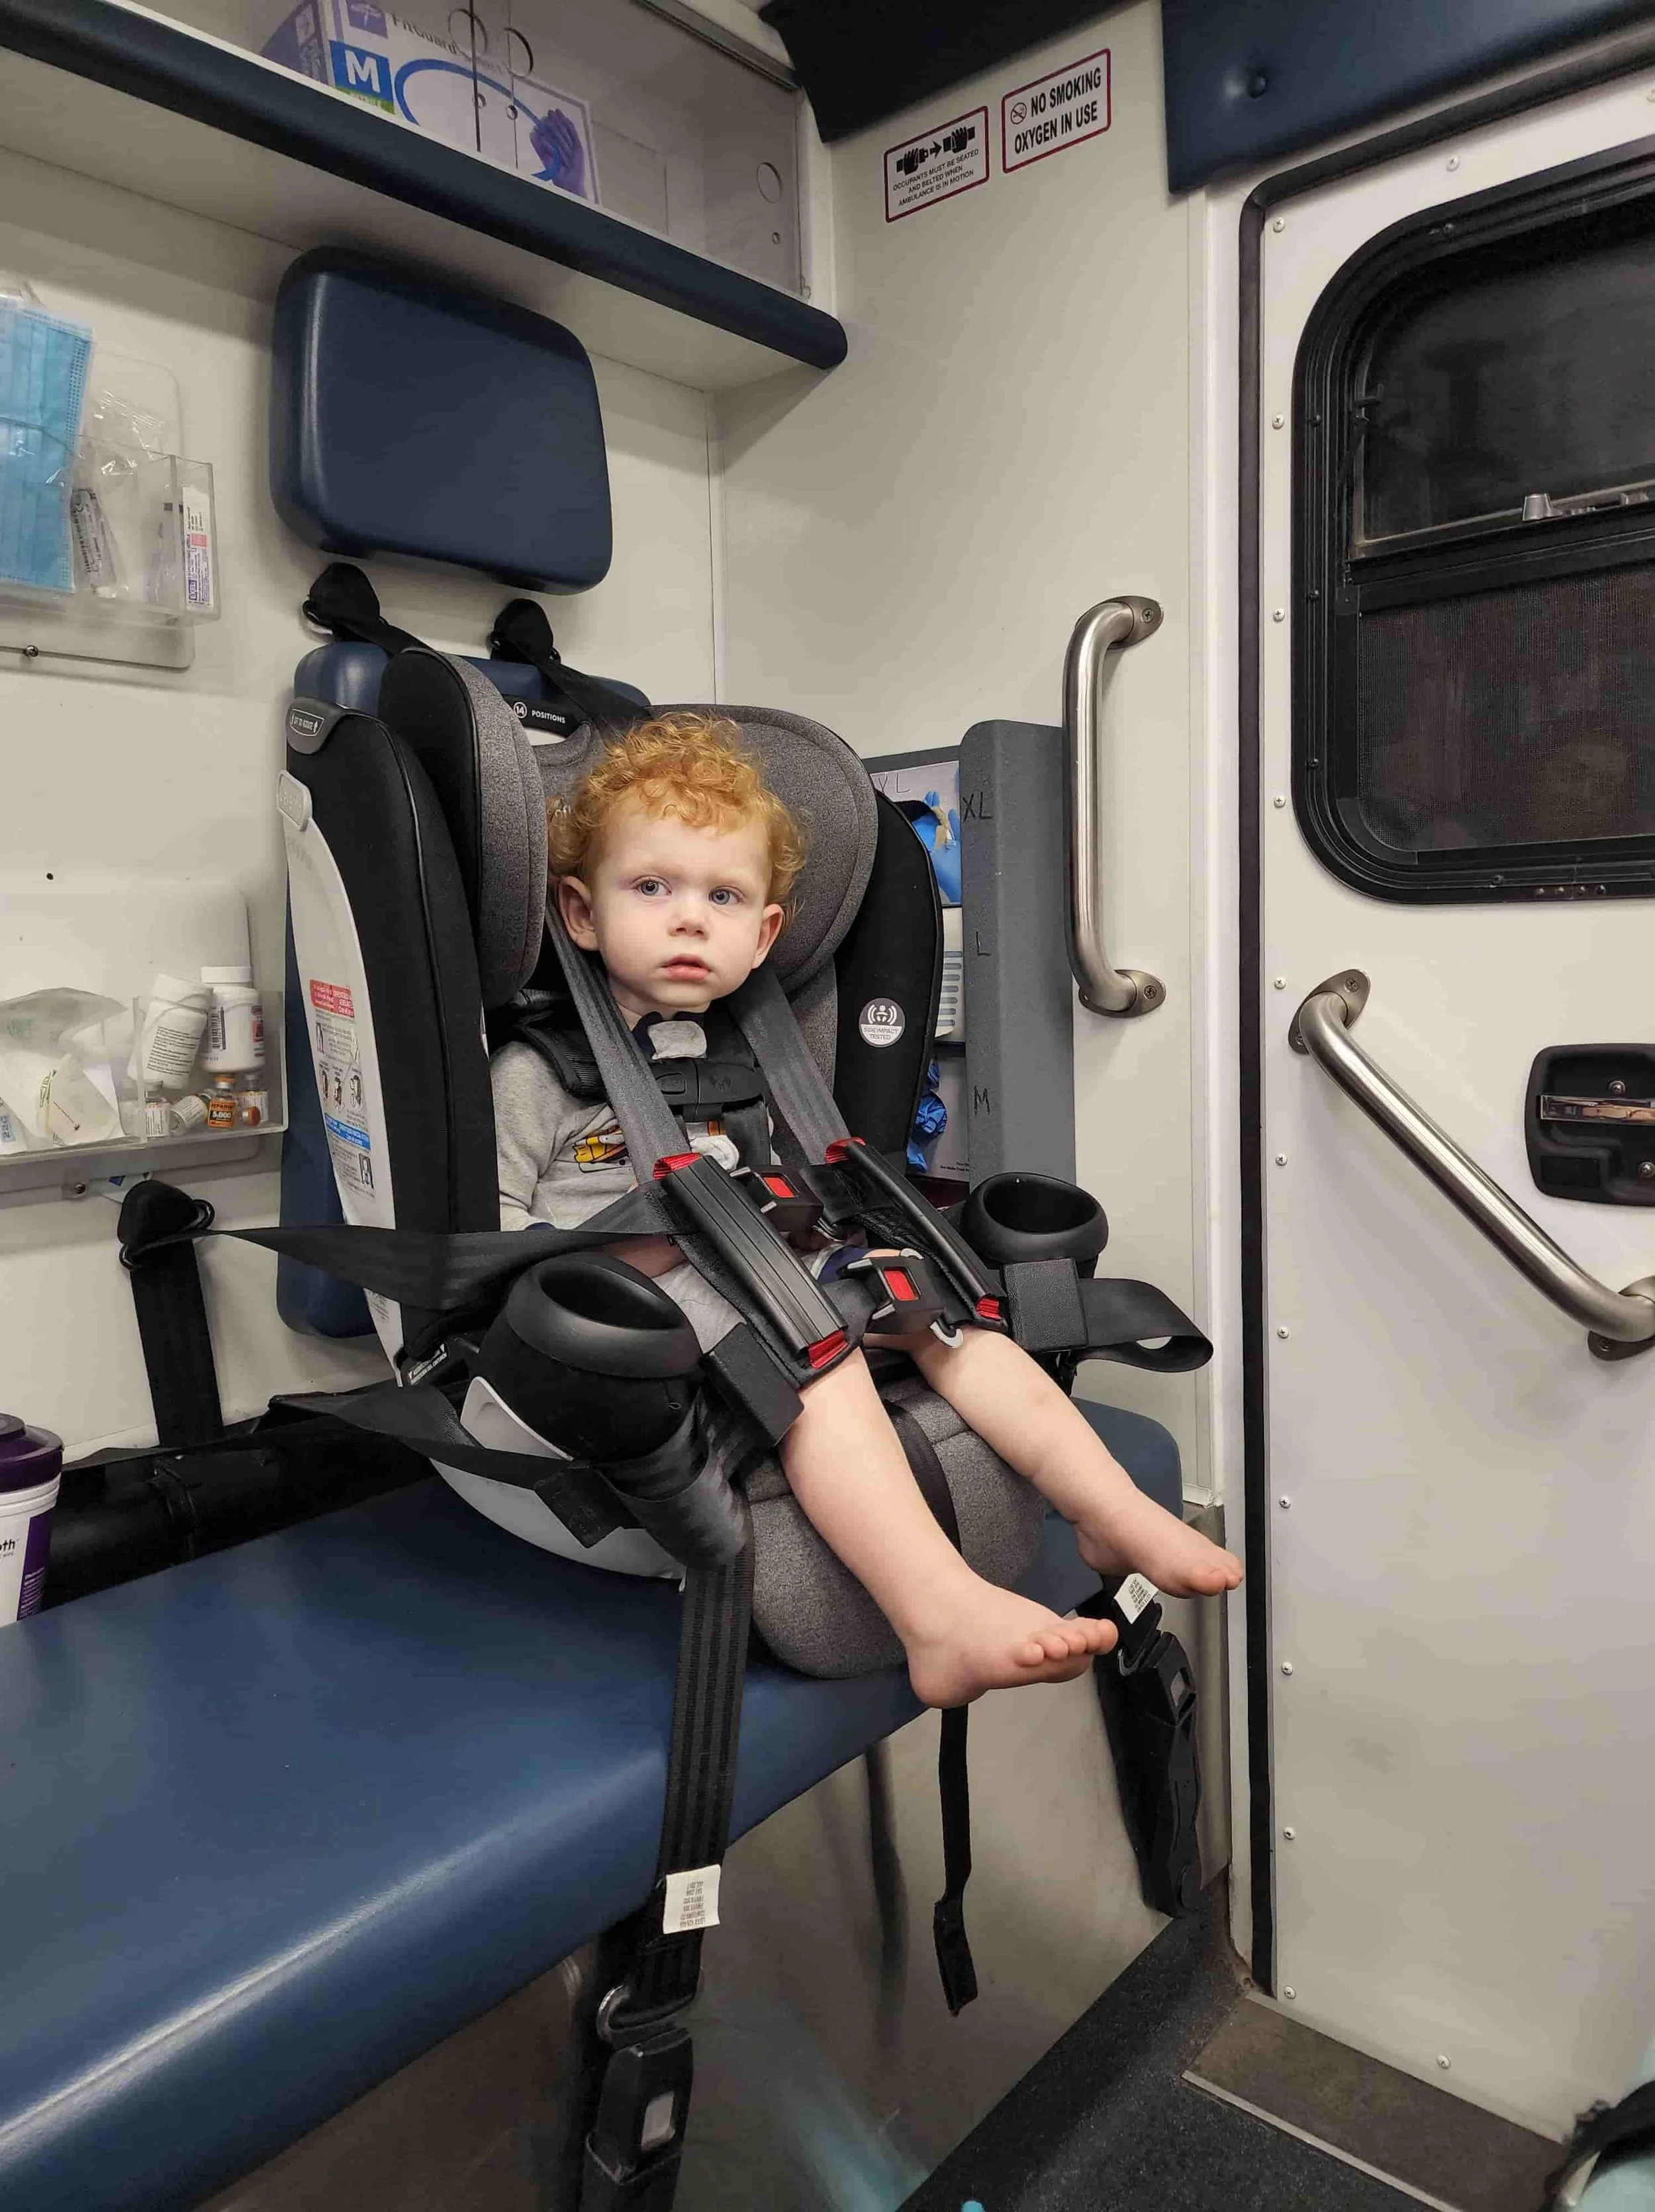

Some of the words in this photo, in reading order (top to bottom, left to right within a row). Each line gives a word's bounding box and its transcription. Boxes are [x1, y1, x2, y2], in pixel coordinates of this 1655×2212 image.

[344, 50, 381, 93] M
[1031, 93, 1046, 117] NO
[1049, 67, 1101, 108] SMOKING
[1014, 117, 1057, 154] OXYGEN
[1061, 111, 1072, 135] IN
[1076, 100, 1098, 128] USE
[892, 171, 927, 191] OCCUPANTS
[929, 163, 946, 175] MUST
[956, 149, 979, 162] SEATED
[908, 183, 921, 193] AND
[922, 173, 944, 187] BELTED
[945, 165, 963, 177] WHEN
[898, 187, 935, 207] AMBULANCE
[942, 178, 949, 187] IN
[949, 169, 974, 185] MOTION
[515, 704, 526, 716] 14
[532, 710, 566, 724] POSITIONS
[962, 791, 994, 822] XL
[975, 931, 992, 956] L
[974, 1085, 990, 1115] M
